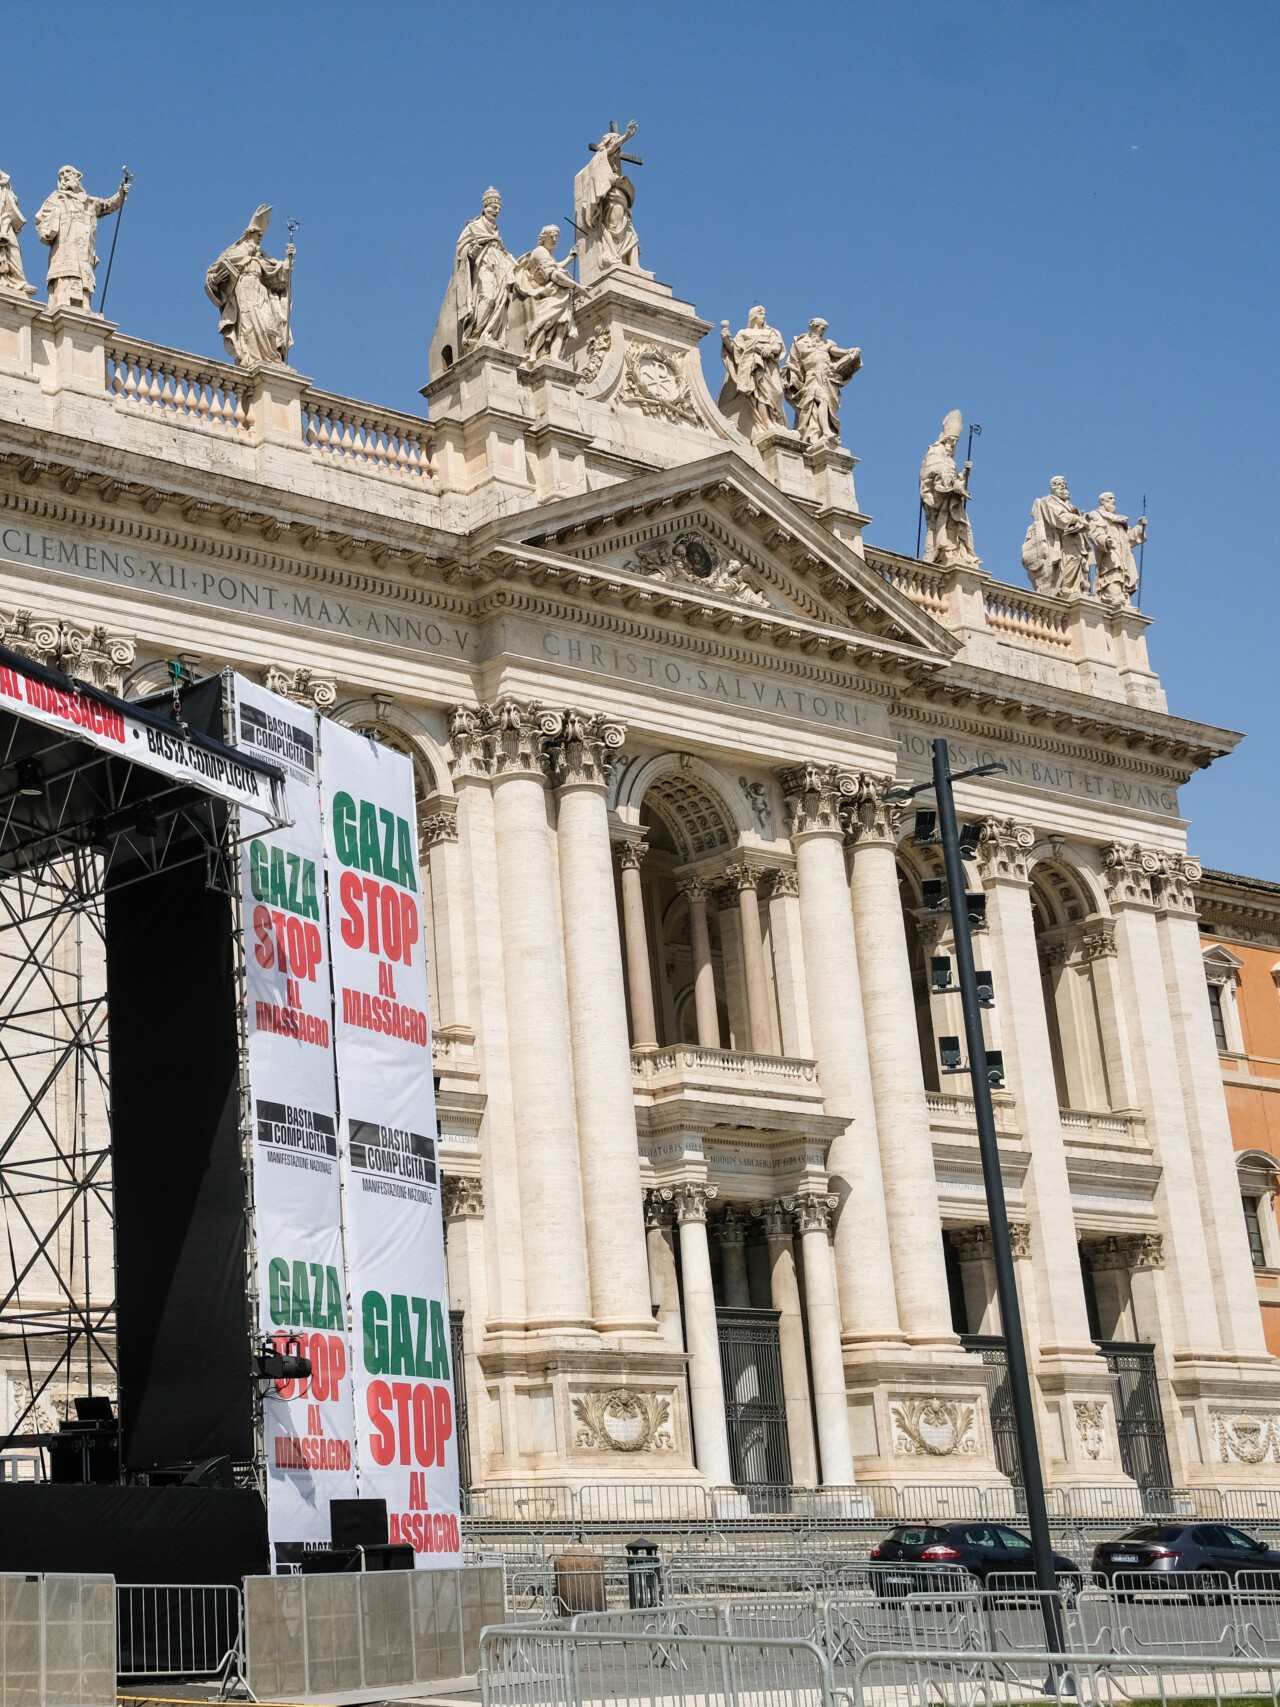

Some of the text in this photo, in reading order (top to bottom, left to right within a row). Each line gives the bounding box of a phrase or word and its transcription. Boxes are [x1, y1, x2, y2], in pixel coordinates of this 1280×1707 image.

[2, 528, 135, 578] CLEMENS
[542, 633, 862, 726] CHRISTO SALVATORI
[0, 664, 23, 699] AL
[24, 677, 125, 744] MASSACRO
[146, 727, 188, 767] BASTA
[267, 714, 293, 742] BASTA
[332, 790, 417, 893] GAZA
[249, 838, 320, 922] GAZA
[340, 870, 419, 967] STOP
[253, 905, 322, 983] STOP
[286, 978, 302, 1011] AL
[378, 960, 396, 999] AL
[255, 1000, 329, 1049] MASSACRO
[342, 987, 427, 1048] MASSACRO
[287, 1105, 313, 1129] BASTA
[380, 1125, 411, 1154] BASTA
[267, 1151, 332, 1175] MANIFESTAZIONE NAZIONALE
[362, 1178, 432, 1205] MANIFESTAZIONE NAZIONALE
[269, 1257, 344, 1331] GAZA
[362, 1290, 450, 1381] GAZA
[272, 1329, 346, 1402] STOP
[308, 1404, 323, 1436] AL
[367, 1379, 452, 1467] STOP
[275, 1436, 351, 1471] MASSACRO
[409, 1472, 428, 1510] AL
